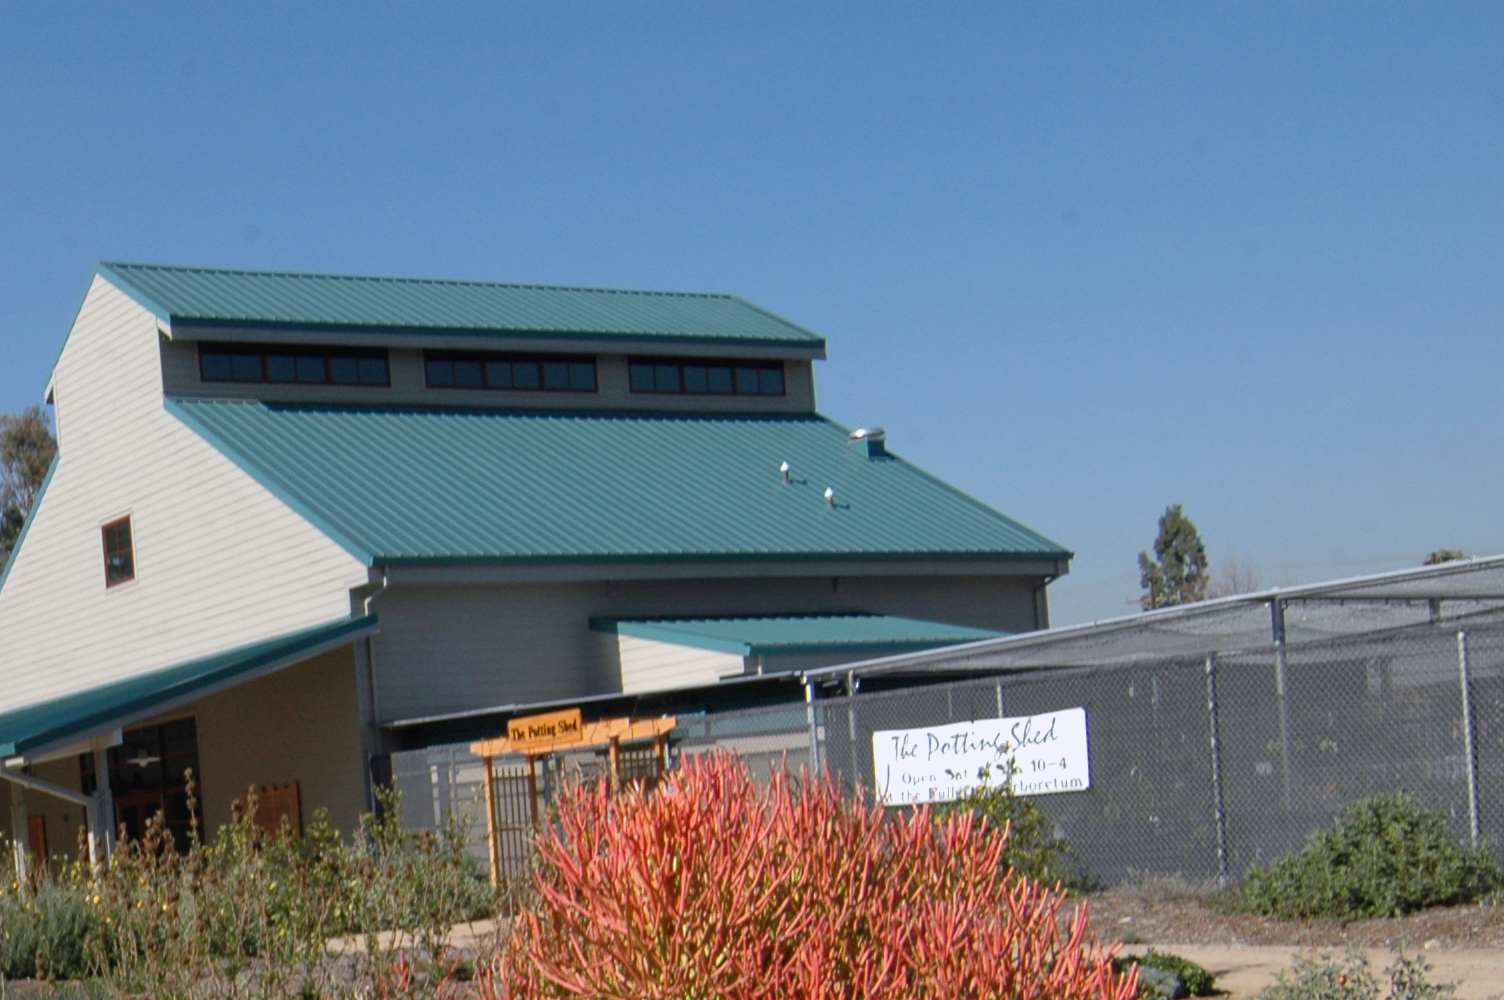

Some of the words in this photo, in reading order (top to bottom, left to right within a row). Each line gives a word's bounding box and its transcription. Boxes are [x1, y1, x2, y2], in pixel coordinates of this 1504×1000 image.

[511, 727, 525, 741] The
[528, 722, 556, 738] Potting
[558, 718, 577, 734] Shed
[891, 733, 918, 762] The
[927, 731, 1002, 762] Potting
[1011, 717, 1058, 752] Shed
[902, 772, 937, 786] Open
[1031, 757, 1067, 773] 10-4
[1007, 778, 1083, 793] rboretum
